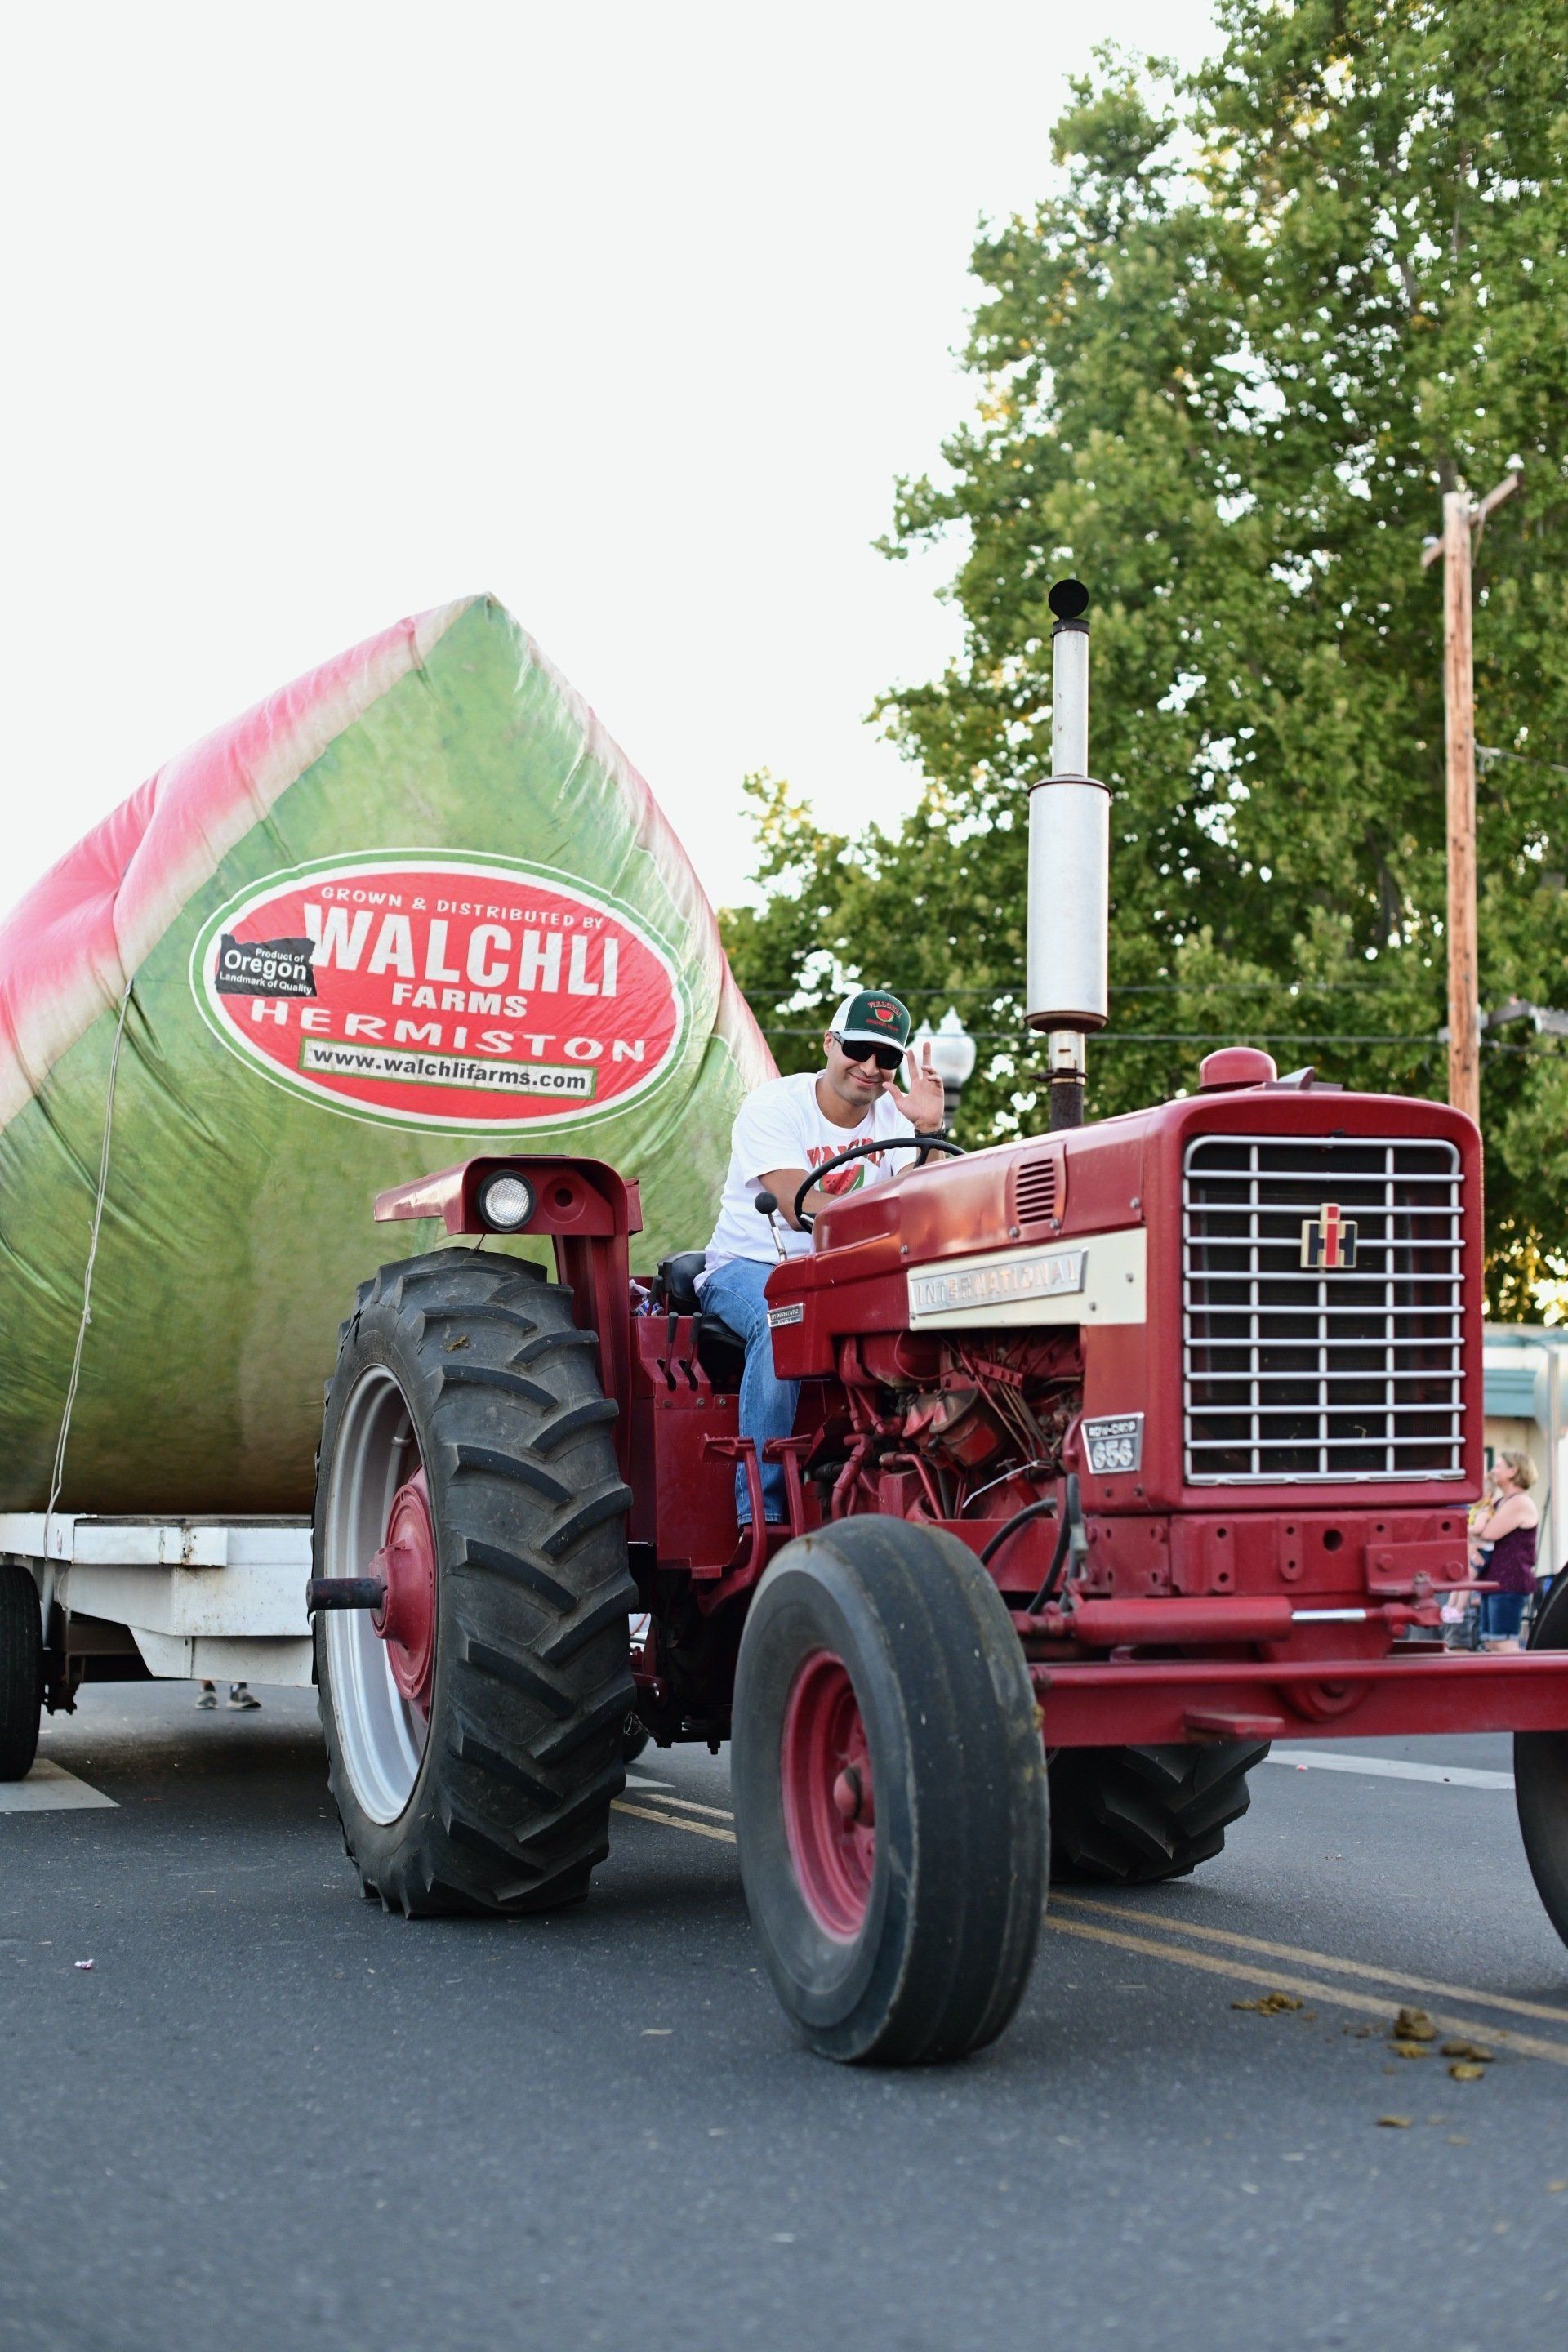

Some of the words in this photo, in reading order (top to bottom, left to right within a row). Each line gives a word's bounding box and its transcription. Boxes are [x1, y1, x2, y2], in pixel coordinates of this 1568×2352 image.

[321, 886, 402, 907] GROWN
[412, 898, 427, 911] &
[436, 899, 575, 927] DISTRIBUTED
[582, 916, 604, 929] BY
[224, 949, 307, 981] Oregon
[255, 947, 292, 962] Product
[293, 954, 305, 963] of
[303, 902, 619, 997] WALCHLI
[219, 971, 266, 987] Landmark
[267, 979, 278, 989] of
[278, 981, 313, 996] Quality
[391, 982, 528, 1018] FARMS
[250, 999, 645, 1062] HERMISTON
[313, 1049, 586, 1089] www.walchlifarms.com
[916, 1256, 1077, 1307] INTERNATIONAL
[1092, 1438, 1134, 1469] 656
